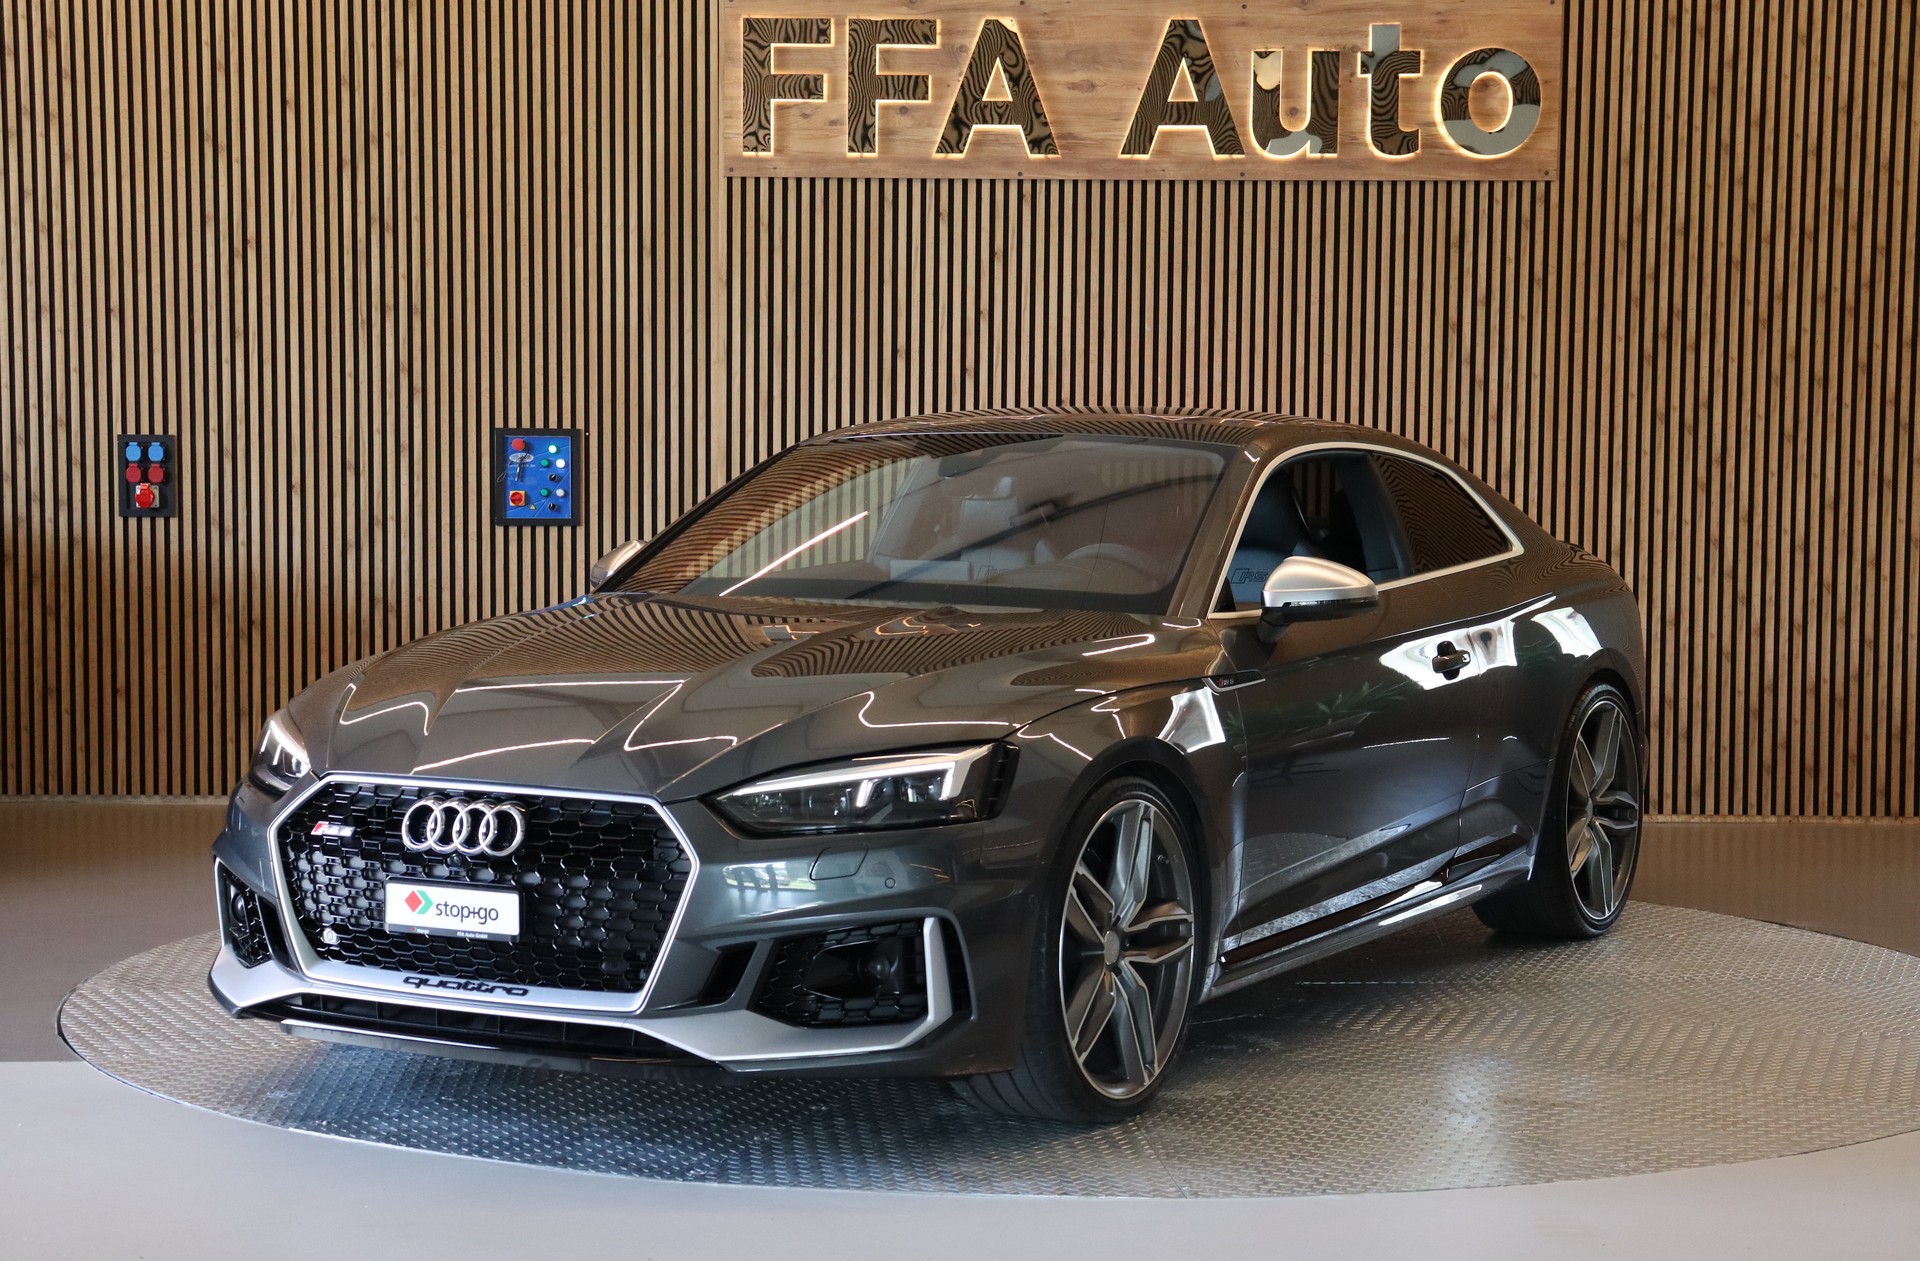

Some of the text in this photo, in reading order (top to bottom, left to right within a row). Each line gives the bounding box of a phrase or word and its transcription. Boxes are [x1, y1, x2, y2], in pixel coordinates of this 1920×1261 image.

[741, 17, 1543, 161] FFA Auto
[435, 901, 499, 925] stop+go
[403, 976, 529, 996] quattro
